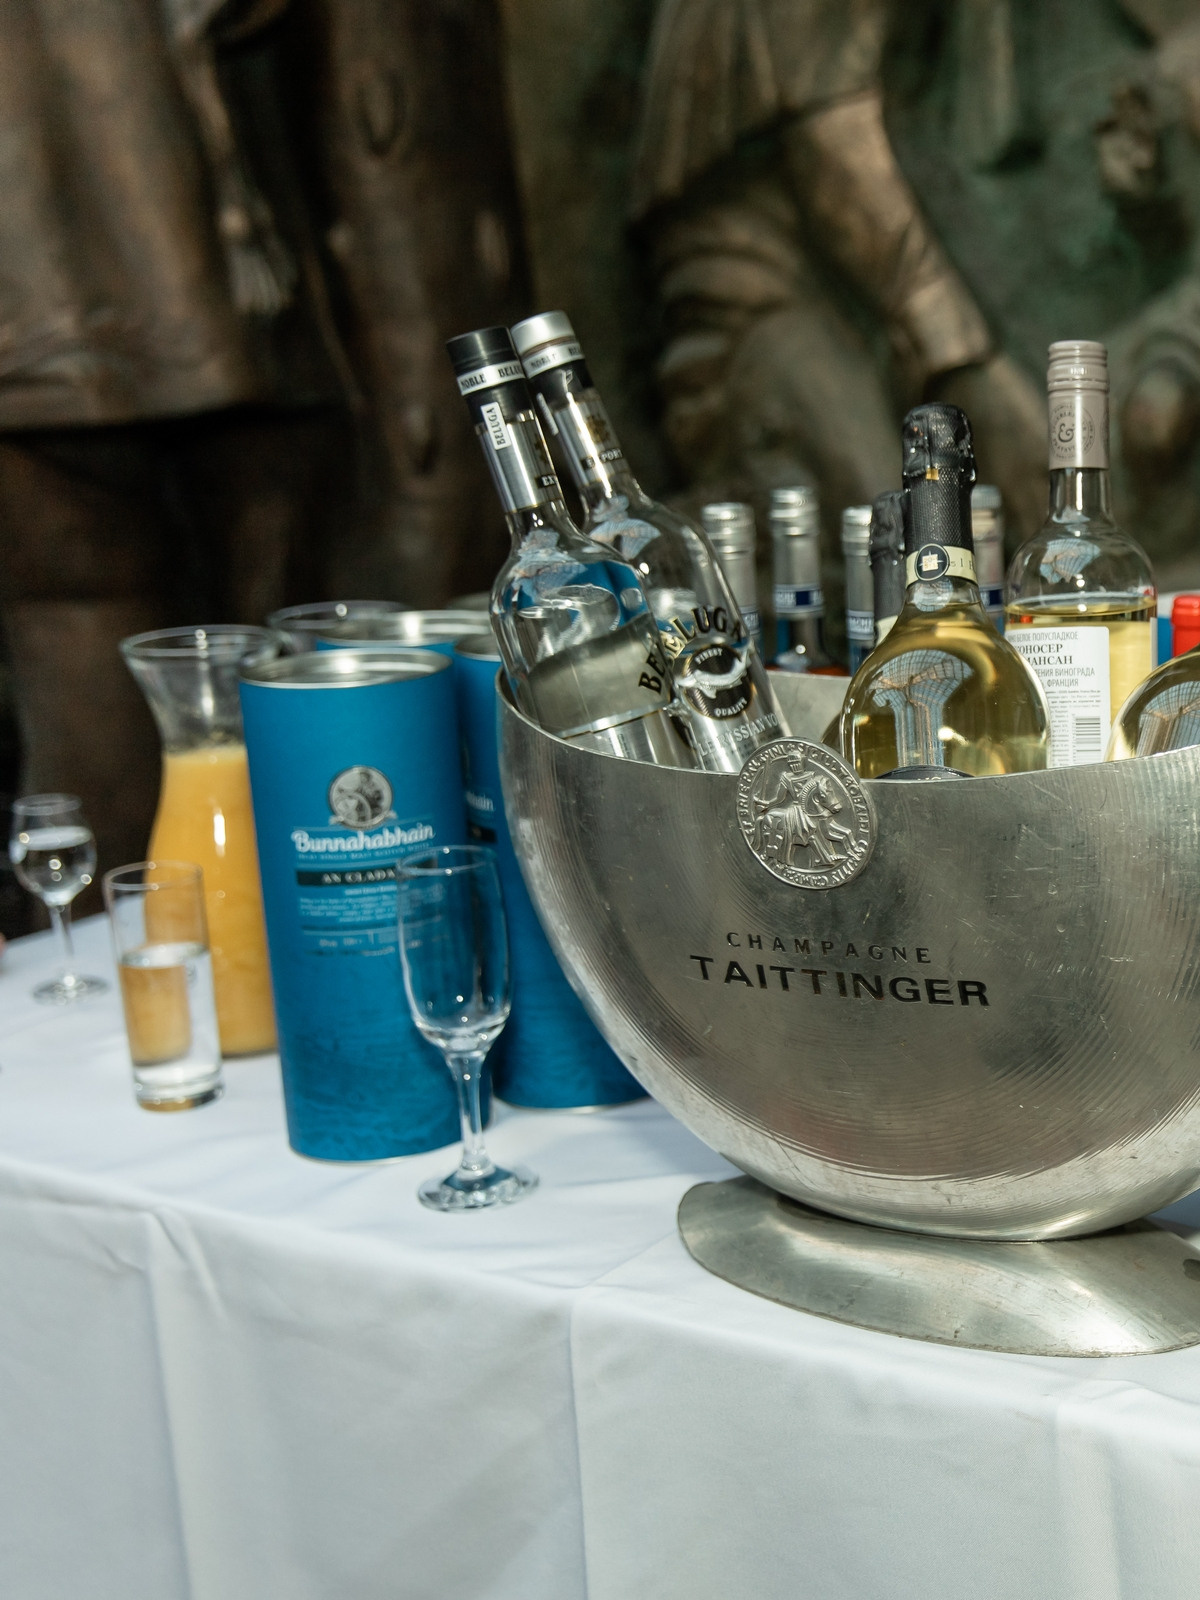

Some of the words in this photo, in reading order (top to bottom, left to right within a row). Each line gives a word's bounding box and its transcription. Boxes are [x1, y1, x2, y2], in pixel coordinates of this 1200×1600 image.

[498, 365, 522, 378] BELU
[486, 407, 506, 446] BELUGA
[1032, 631, 1079, 641] ПОЛУСЛАДКОЕ
[1016, 643, 1064, 655] ОНОСЕР
[1054, 667, 1095, 677] ВИНОГРАДА
[1047, 678, 1079, 688] ФРАНЦИЯ
[290, 822, 436, 853] Bunnahabhain
[726, 931, 932, 964] CHAMPAGNE
[690, 954, 991, 1008] TAITTINGER
